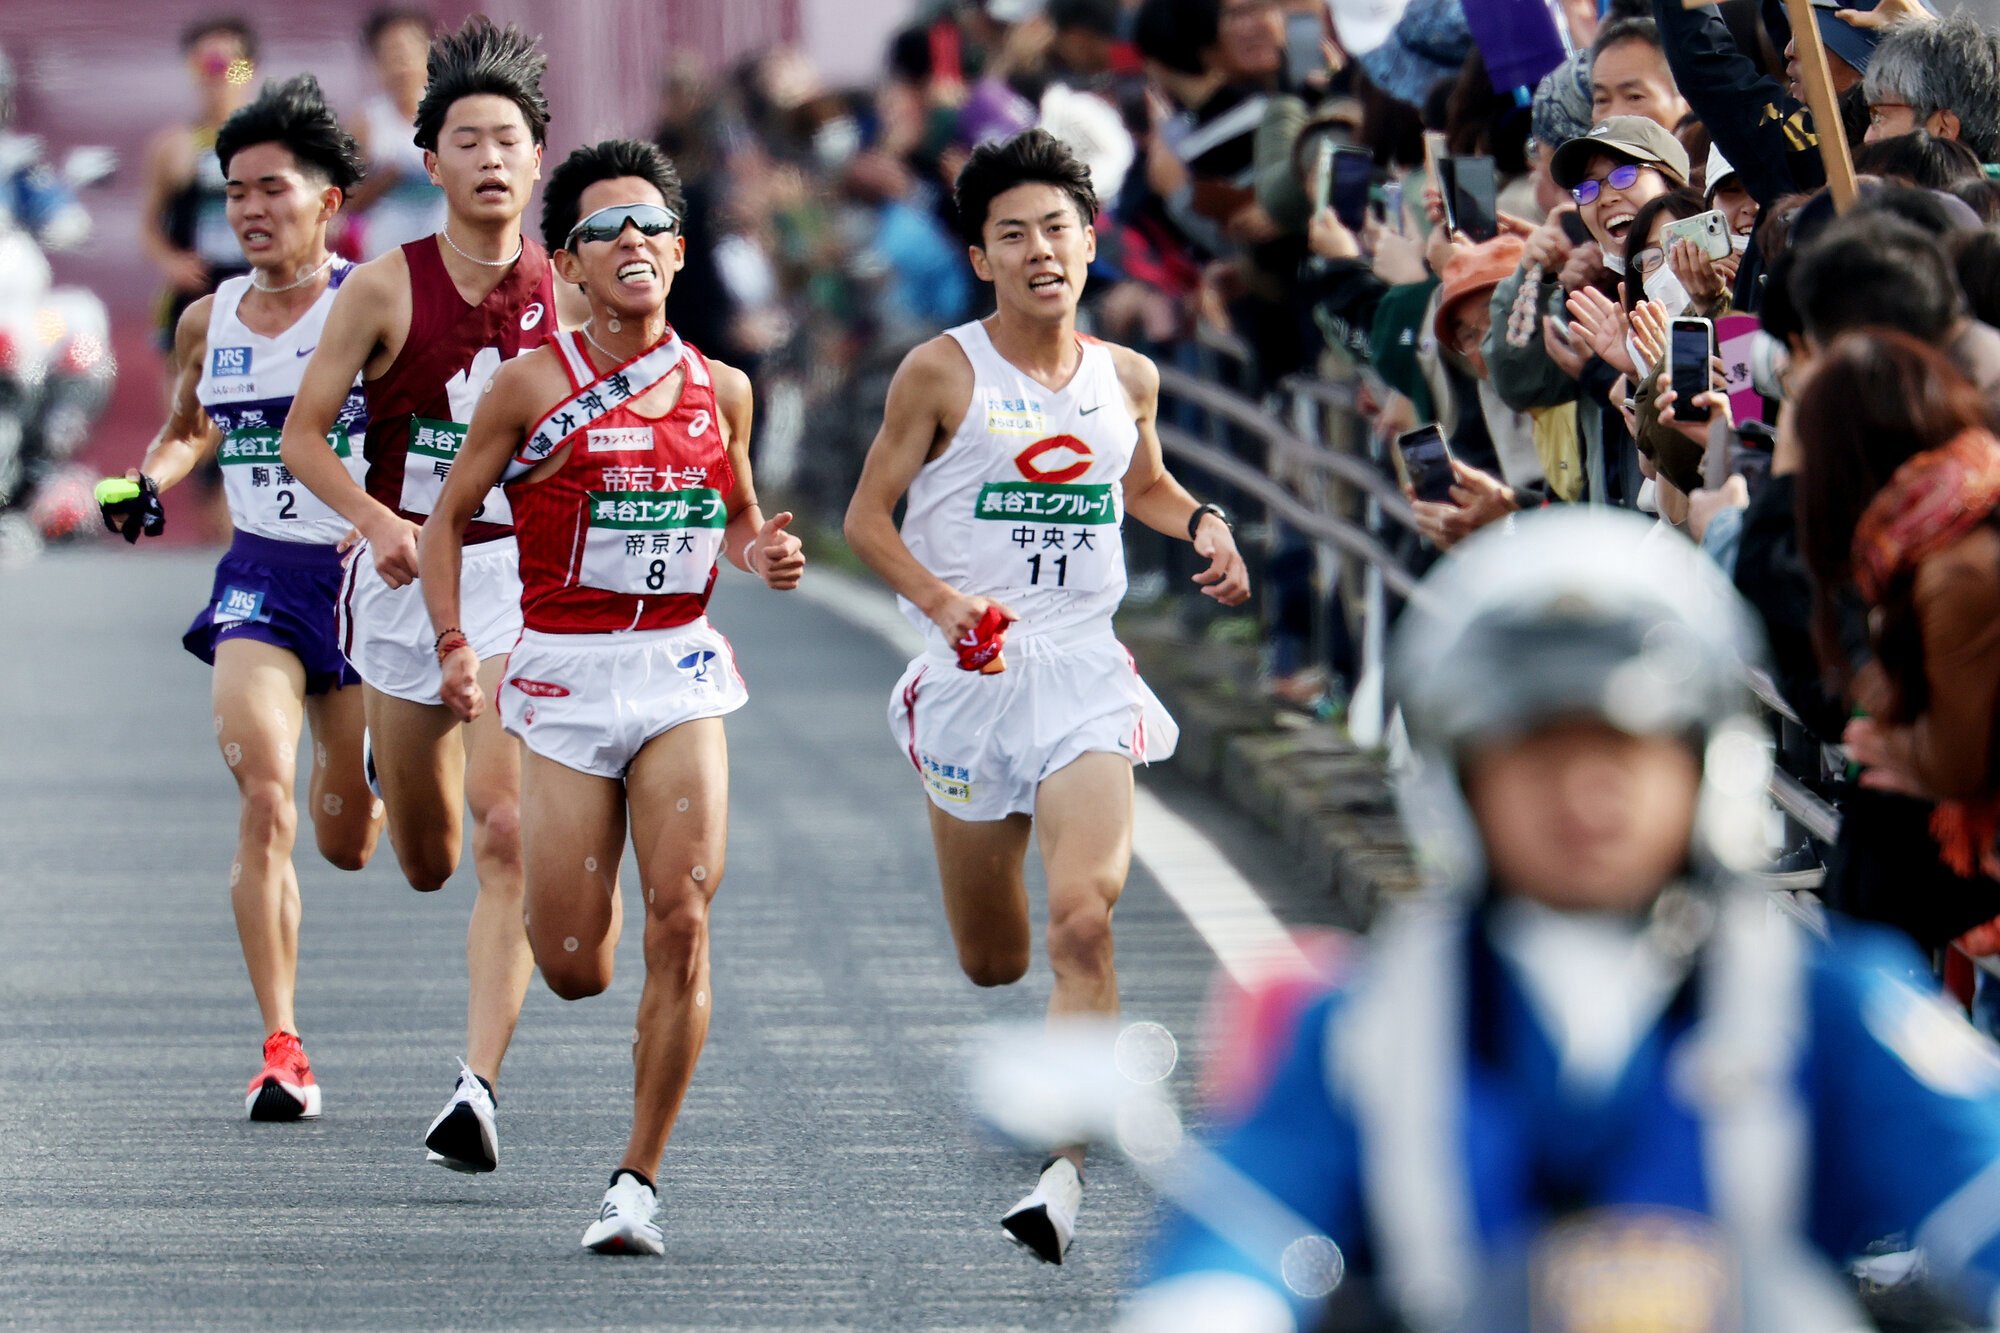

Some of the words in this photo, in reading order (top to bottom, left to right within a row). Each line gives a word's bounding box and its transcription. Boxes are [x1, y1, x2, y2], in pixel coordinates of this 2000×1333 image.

[432, 461, 451, 482] 早
[602, 465, 707, 492] 帝京大学
[276, 490, 298, 519] 2
[625, 532, 695, 555] 帝京大
[1012, 525, 1096, 550] 中央大
[646, 559, 666, 590] 8
[1027, 554, 1067, 586] 11
